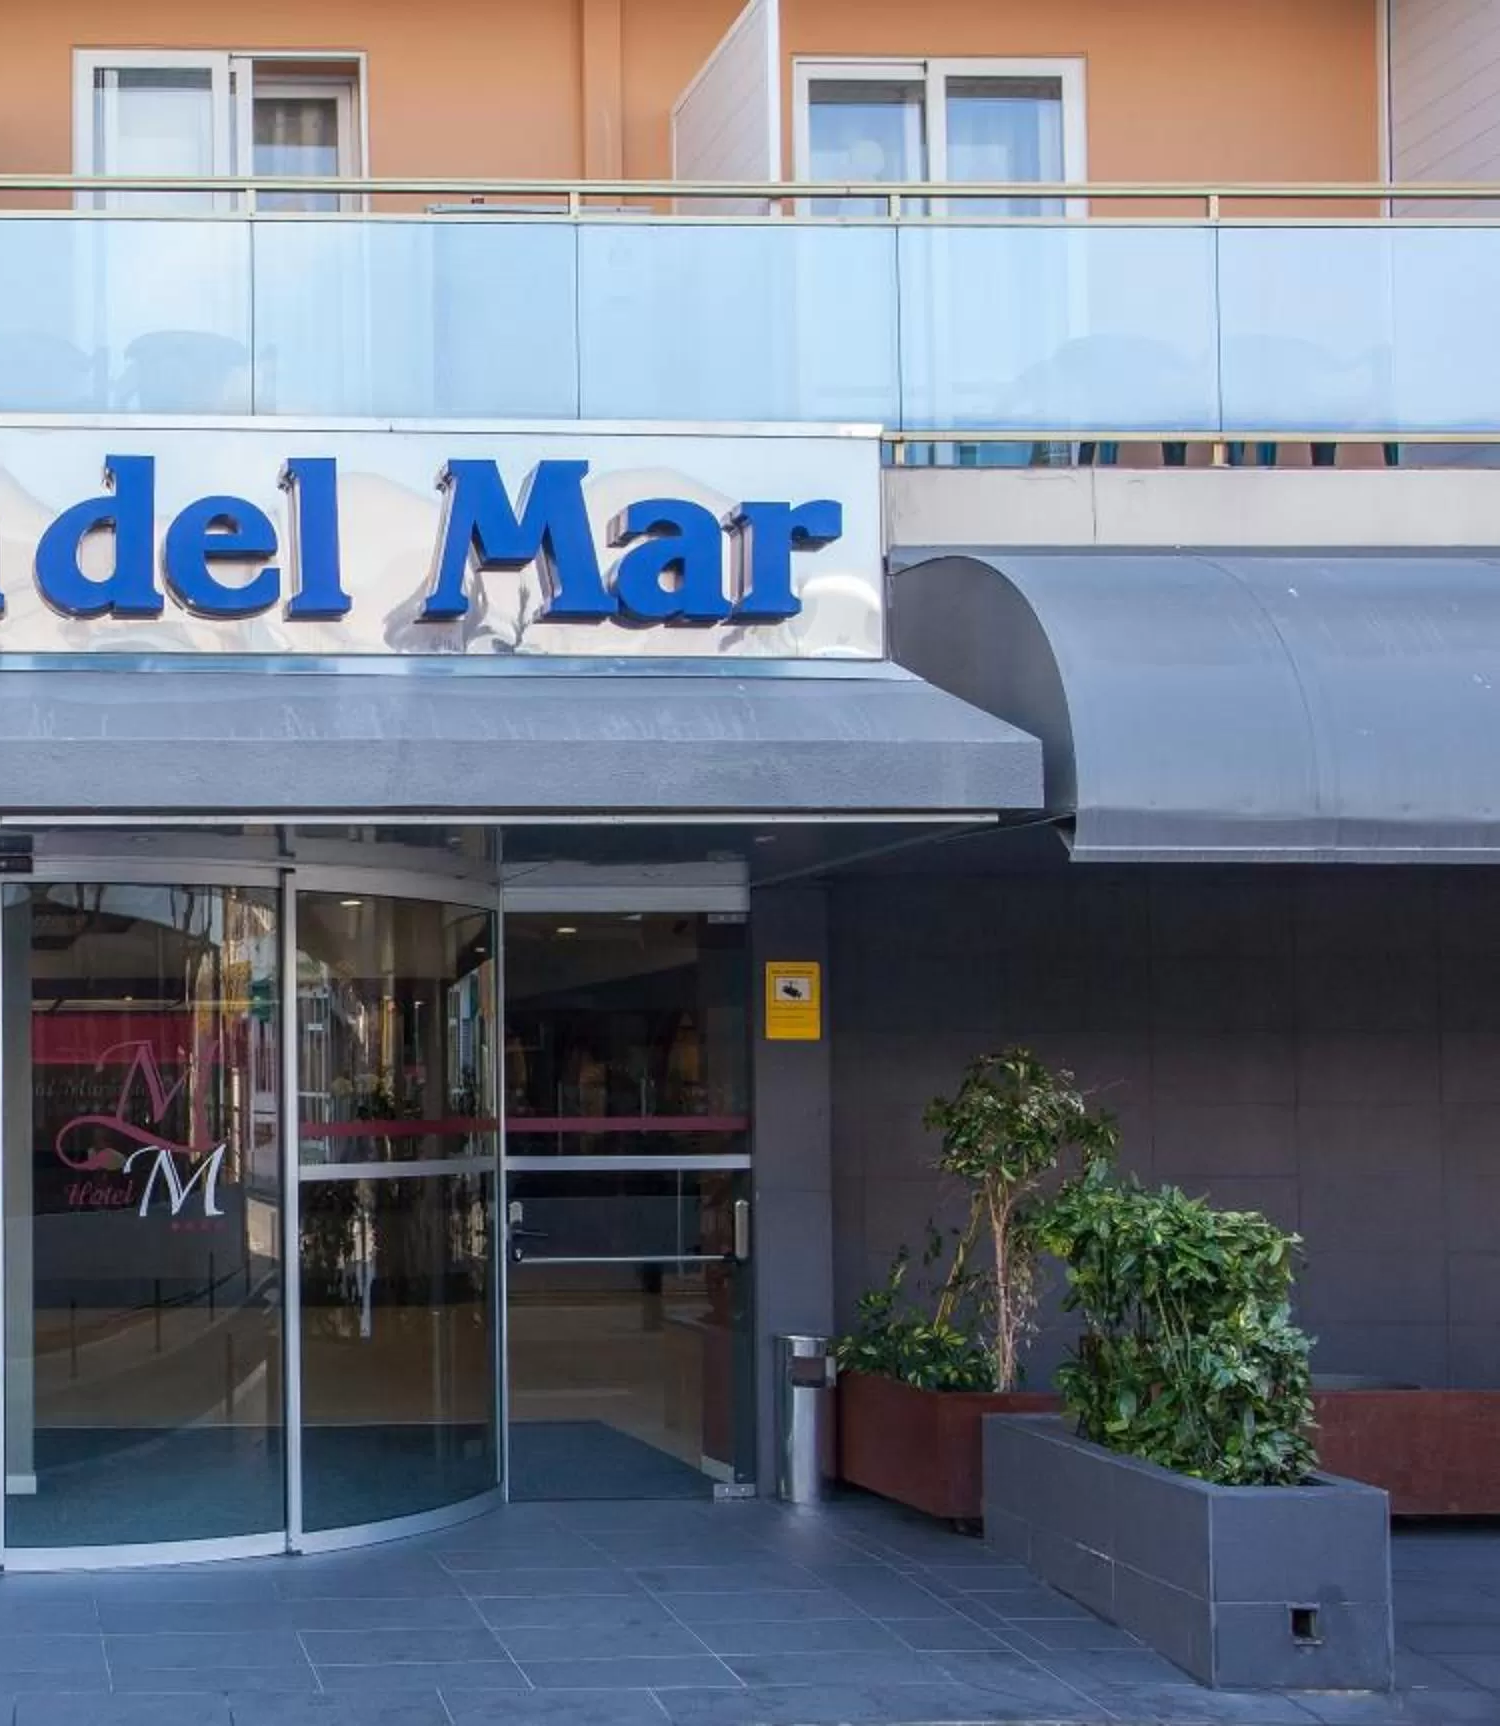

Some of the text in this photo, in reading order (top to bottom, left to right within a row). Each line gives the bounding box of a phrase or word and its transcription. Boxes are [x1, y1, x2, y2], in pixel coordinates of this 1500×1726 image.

[35, 454, 352, 620] del
[414, 459, 842, 626] Mar
[123, 1142, 227, 1218] M
